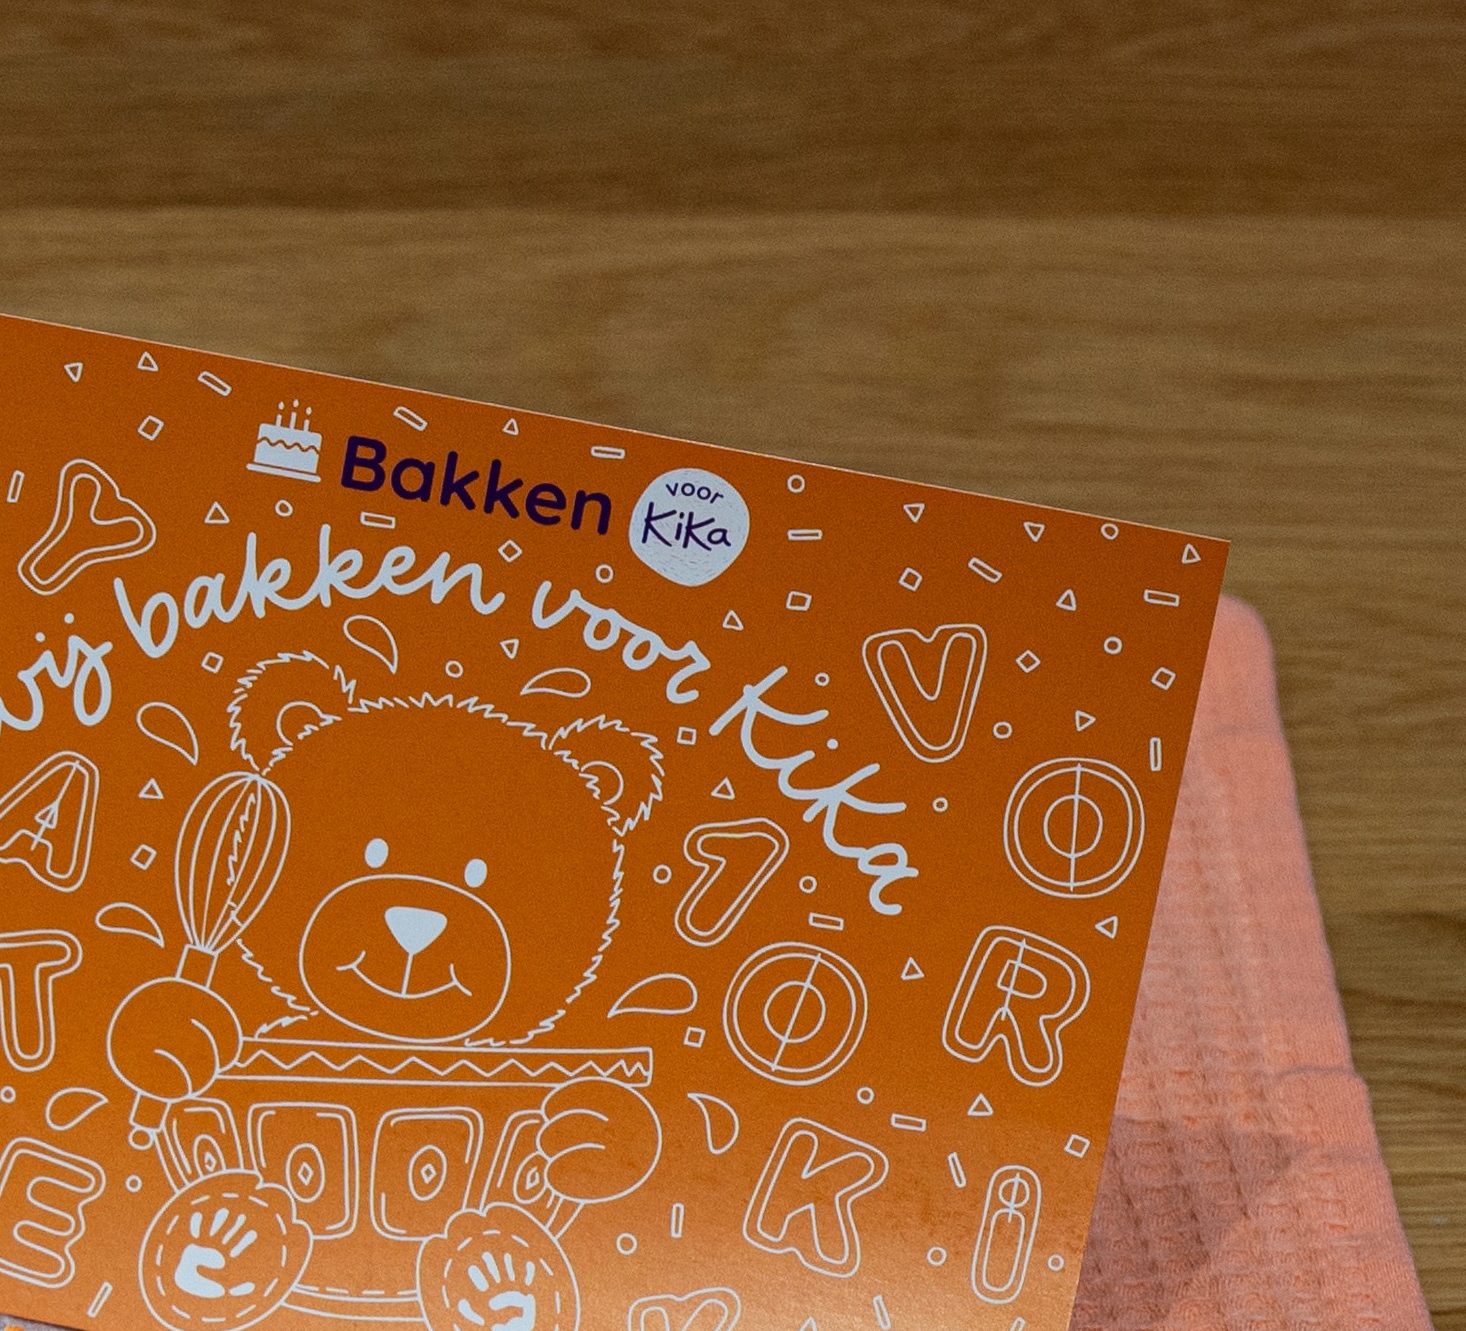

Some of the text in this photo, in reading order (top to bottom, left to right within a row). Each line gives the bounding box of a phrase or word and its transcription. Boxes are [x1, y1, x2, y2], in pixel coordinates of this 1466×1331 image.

[340, 435, 612, 536] Bakken
[665, 479, 725, 504] voor
[113, 523, 505, 658] bakken
[531, 580, 711, 704] voor
[743, 1117, 889, 1278] K
